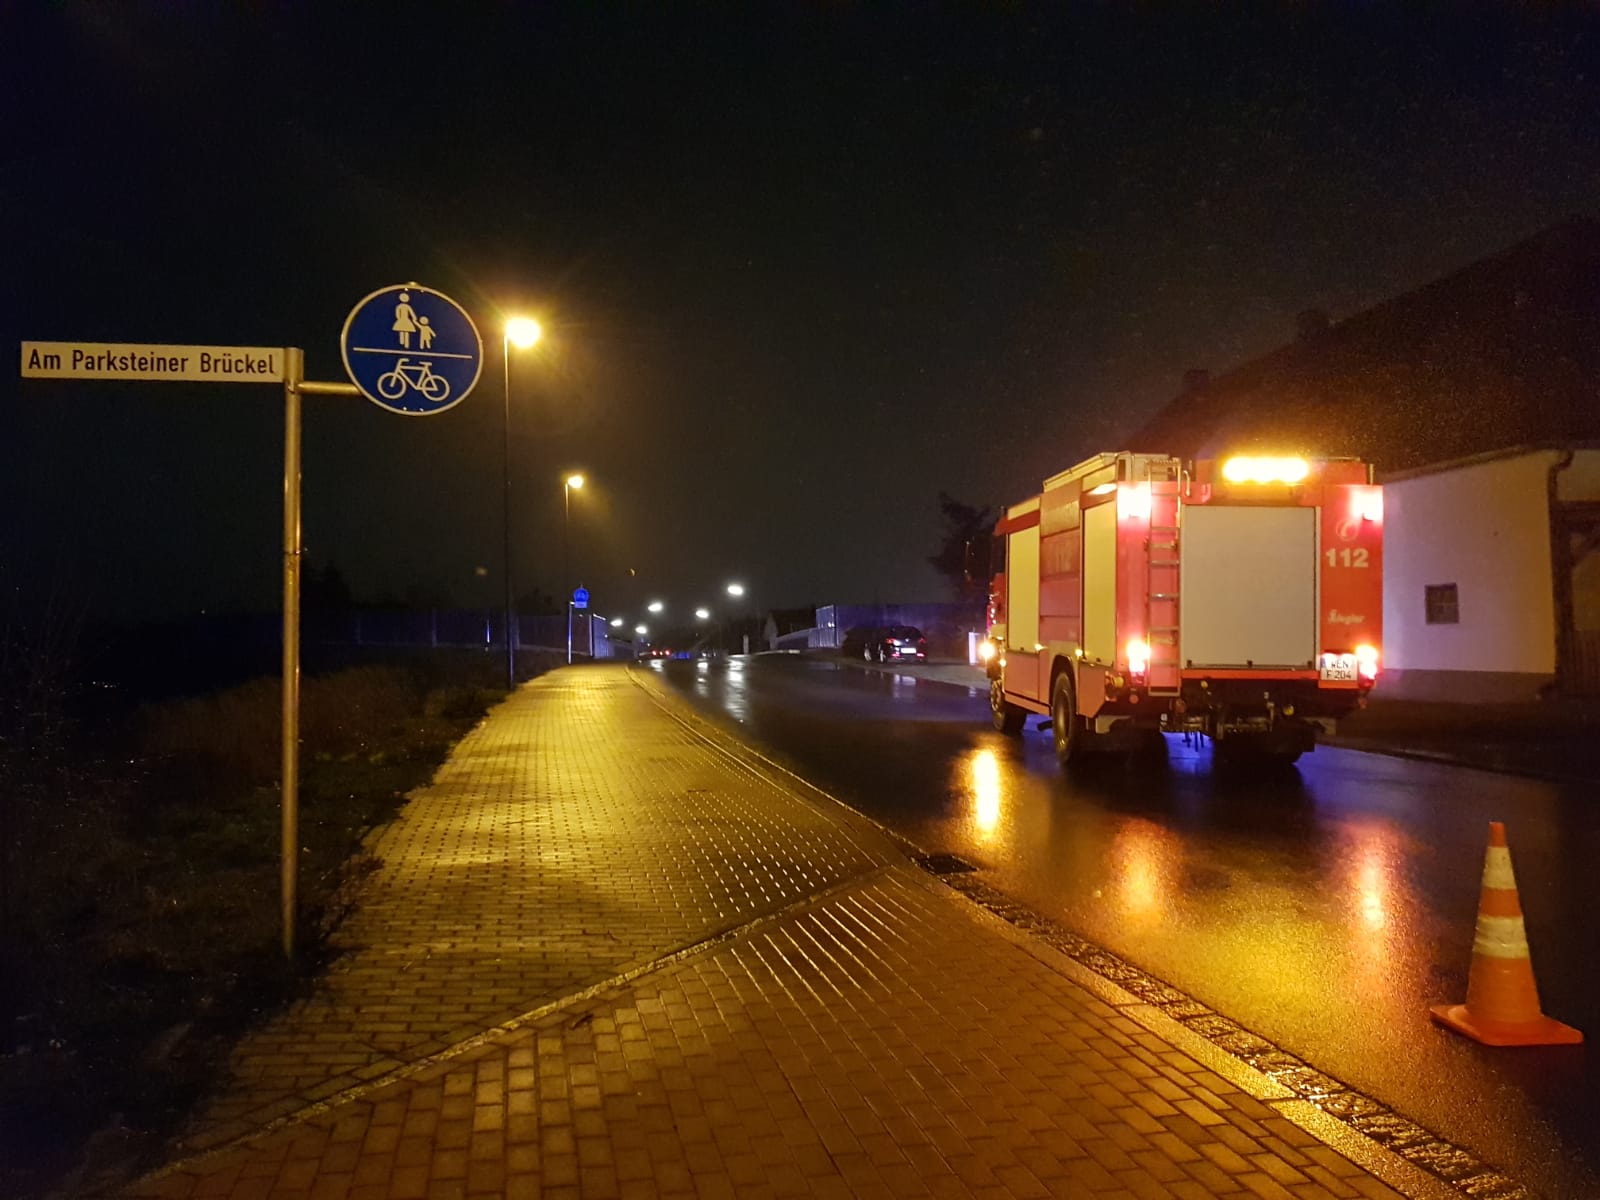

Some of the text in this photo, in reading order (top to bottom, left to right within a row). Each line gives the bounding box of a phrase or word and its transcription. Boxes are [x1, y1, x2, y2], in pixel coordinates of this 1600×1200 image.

[28, 349, 275, 374] Am Parksteiner Brückel
[1326, 548, 1369, 568] 112
